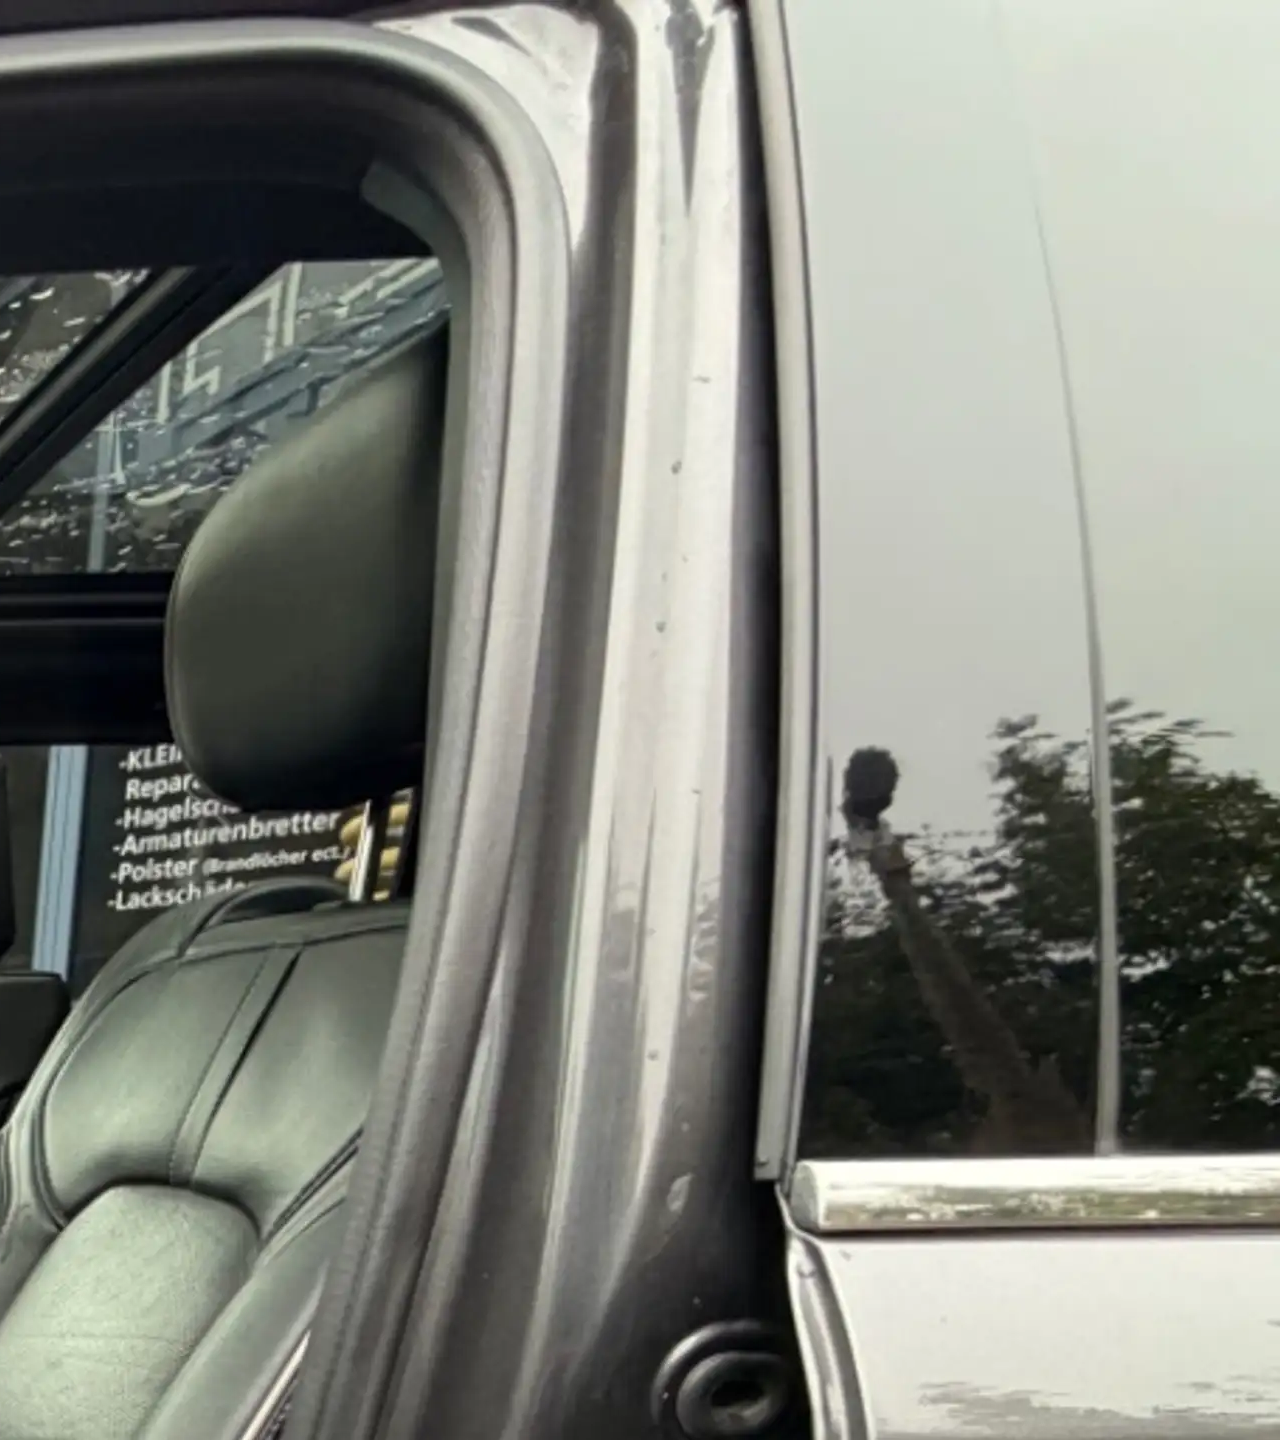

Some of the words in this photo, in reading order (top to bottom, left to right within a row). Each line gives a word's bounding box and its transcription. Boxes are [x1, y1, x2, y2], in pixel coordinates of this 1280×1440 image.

[118, 743, 183, 772] -KLEI
[112, 812, 341, 855] -Armaturenbretter
[109, 857, 199, 884] -Polster
